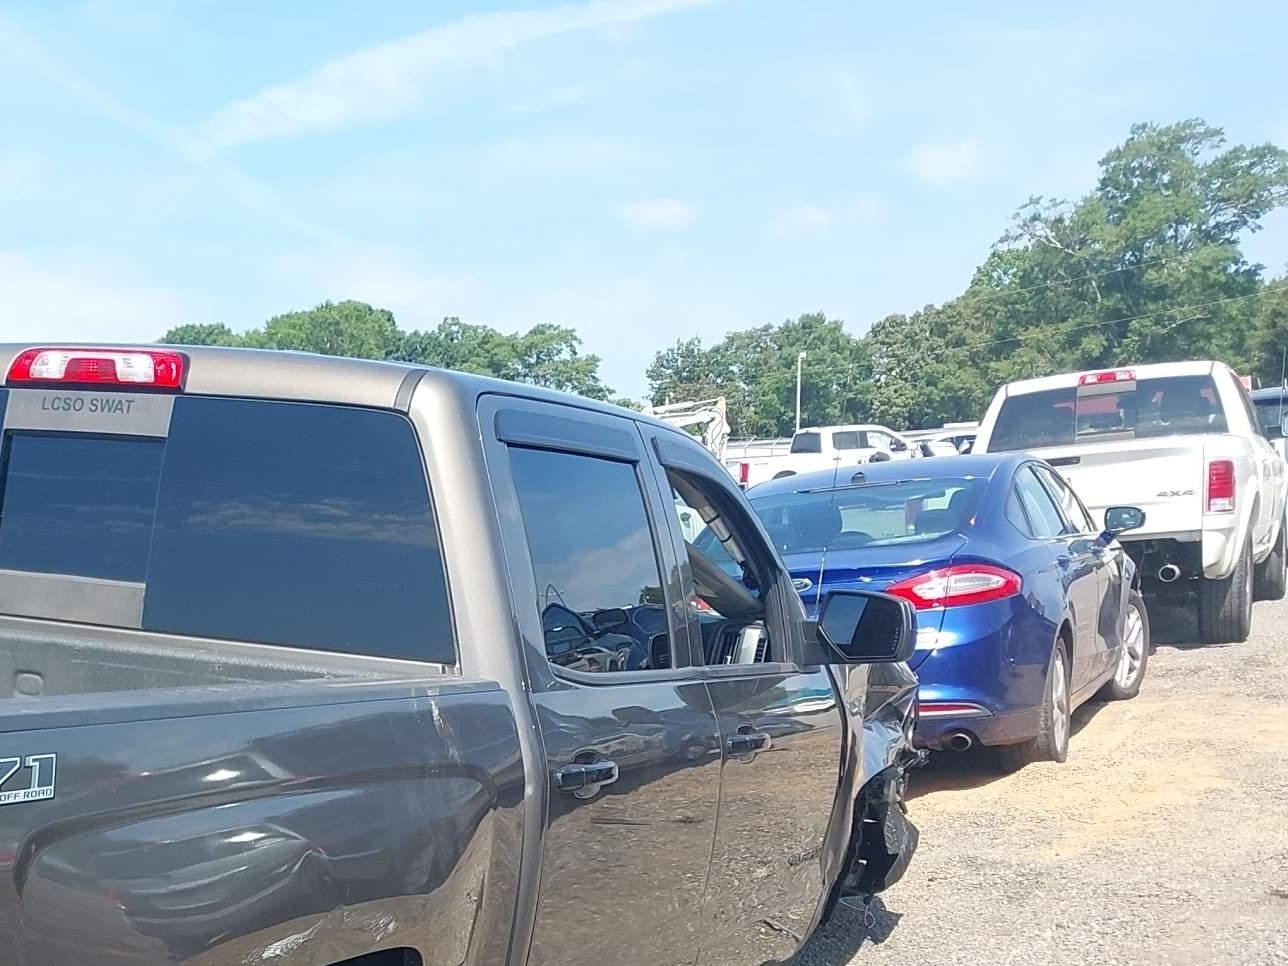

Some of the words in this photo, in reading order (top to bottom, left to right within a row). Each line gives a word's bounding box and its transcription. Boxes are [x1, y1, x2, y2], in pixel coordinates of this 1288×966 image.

[41, 396, 85, 412] LCSO
[89, 398, 135, 414] SWAT
[0, 792, 21, 802] OFF
[23, 788, 53, 799] ROAD
